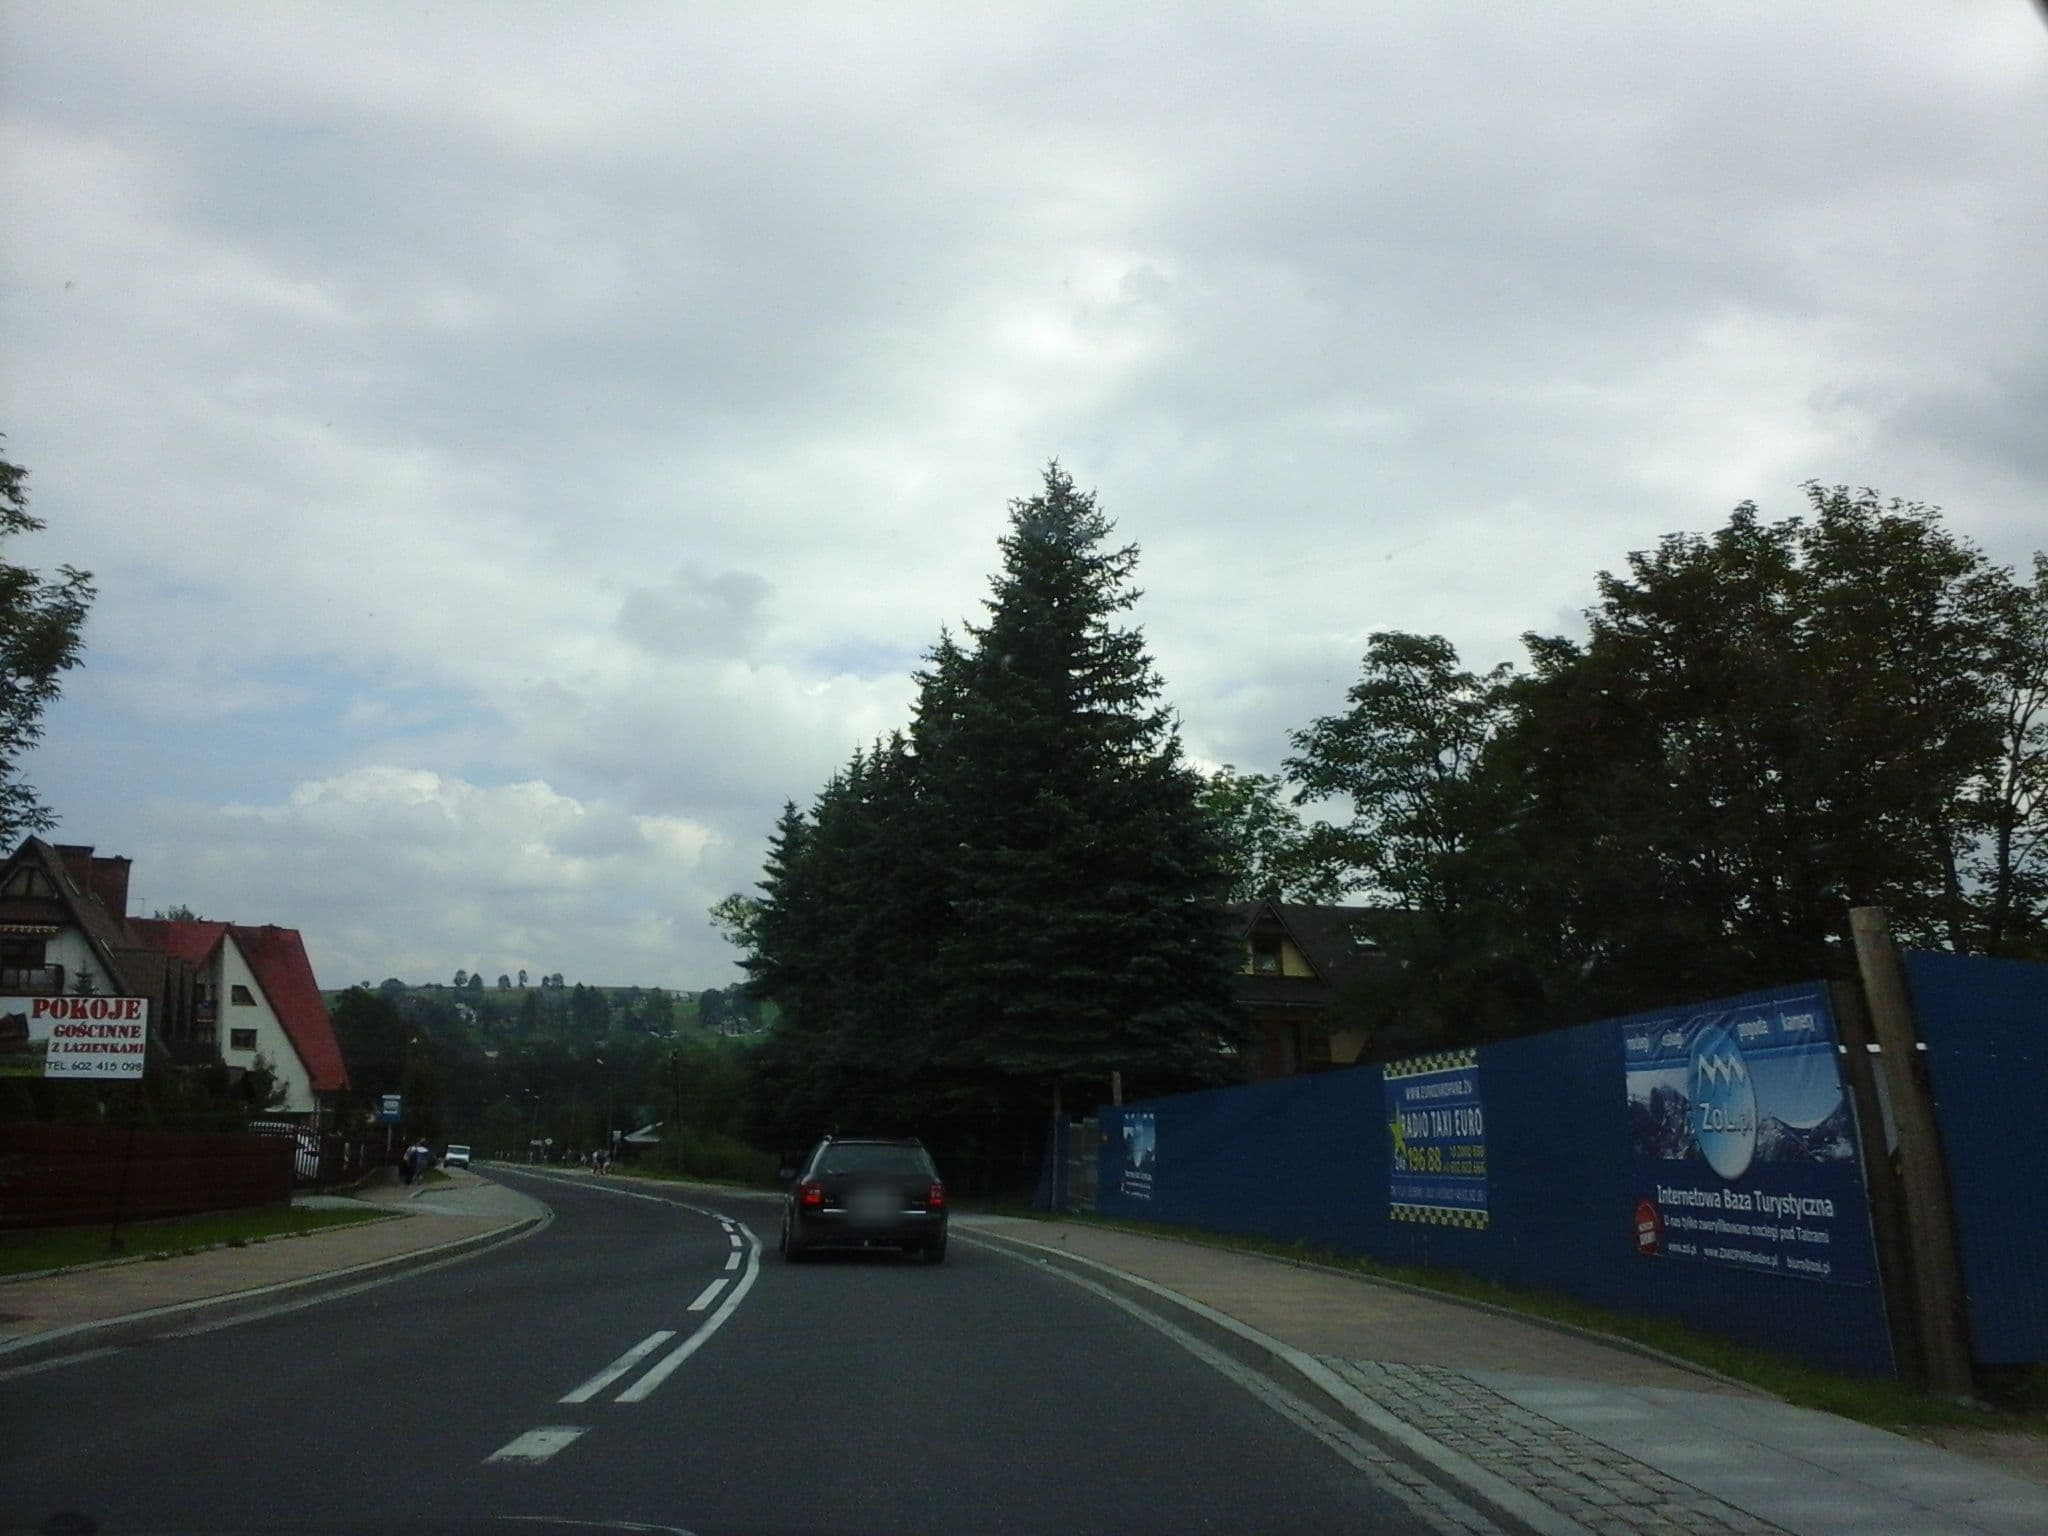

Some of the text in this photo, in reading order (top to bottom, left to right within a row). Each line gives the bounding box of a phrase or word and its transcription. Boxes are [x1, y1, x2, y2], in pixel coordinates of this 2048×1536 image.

[32, 999, 141, 1020] POKOJE
[54, 1021, 141, 1038] GOŚCINNE
[51, 1043, 60, 1053] Z
[71, 1061, 92, 1071] 602
[1401, 1107, 1483, 1139] RADIO TAXI EURO
[1657, 1184, 1834, 1220] Internetowa Baza Turystyczna
